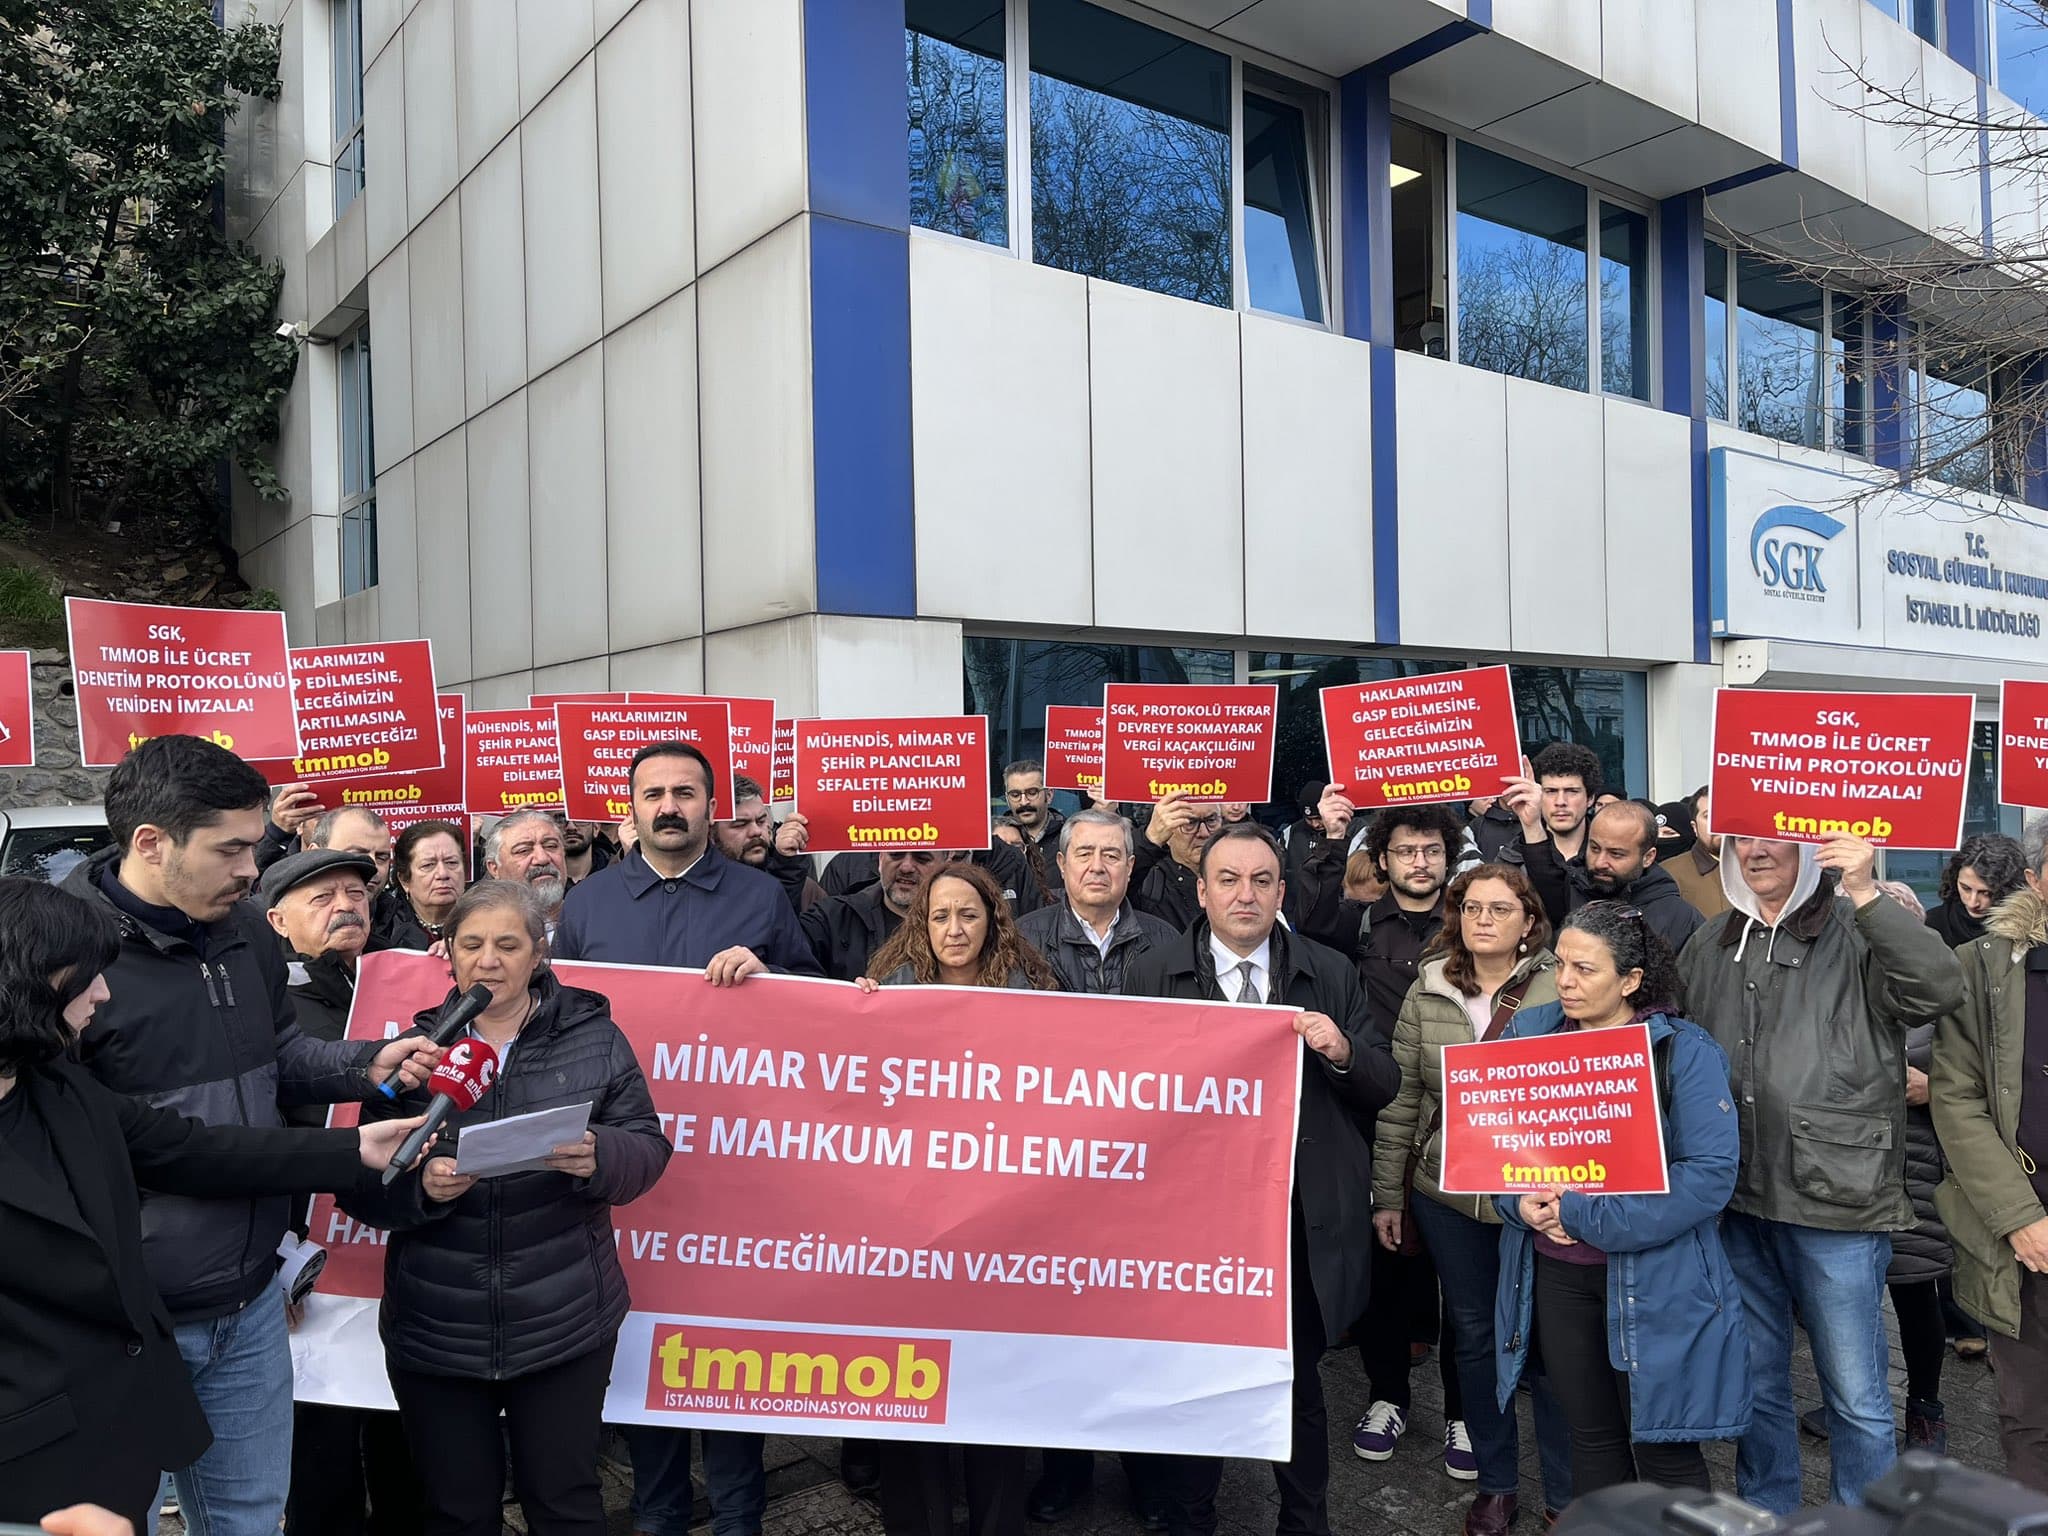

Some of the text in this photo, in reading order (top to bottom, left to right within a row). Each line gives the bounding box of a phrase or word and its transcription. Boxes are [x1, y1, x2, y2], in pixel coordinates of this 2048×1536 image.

[1965, 532, 1989, 559] T.C.
[1763, 538, 1827, 593] SGK
[1887, 549, 1942, 581] SOSYAL
[1944, 557, 2003, 592] GÜVENLİK
[1906, 594, 1963, 629] İSTANBUL
[1964, 603, 1975, 630] İL
[148, 624, 186, 643] SGK,
[99, 646, 252, 666] TMMOB İLE ÜCRET
[291, 651, 385, 670] KLARIMIZIN
[79, 669, 141, 688] DENETİM
[146, 672, 286, 689] PROTOKOLÜNÜ
[306, 669, 403, 690] EDİLMESİNE,
[295, 689, 394, 711] LECEĞİMİZİN
[1359, 679, 1463, 704] HAKLARIMIZIN
[106, 694, 254, 713] YENİDEN İMZALA!
[1110, 703, 1271, 717] SGK, PROTOKOLÜ TEKRAR
[1352, 697, 1481, 724] GASP EDİLMESİNE,
[299, 709, 406, 731] ARTILMASINA
[467, 719, 533, 734] MÜHENDİS,
[591, 711, 687, 723] HAKLARIMIZIN
[1816, 711, 1860, 728] SGK,
[583, 727, 702, 742] GASP EDİLMESİNE,
[730, 726, 751, 736] RET
[1064, 729, 1101, 738] TMMOB
[1117, 722, 1263, 734] DEVREYE SOKMAYARAK
[1364, 716, 1473, 742] GELECEĞİMİZİN
[299, 727, 418, 751] VERMEYECEĞİZ!
[479, 739, 512, 752] ŞEHİR
[806, 730, 894, 749] MÜHENDİS,
[898, 729, 953, 746] MİMAR
[957, 732, 976, 745] VE
[1048, 740, 1090, 751] DENETİM
[1123, 738, 1255, 754] VERGİ KAÇAKÇILIĞINI
[1358, 736, 1486, 761] KARARTILMASINA
[1750, 731, 1931, 752] TMMOB İLE ÜCRET
[2005, 734, 2048, 750] DENE
[292, 747, 390, 773] tmmob
[477, 754, 560, 766] SEFALETE MAH
[821, 753, 960, 773] ŞEHİR PLANCILARI
[1142, 756, 1237, 772] TEŞVİK EDİYOR!
[1354, 754, 1498, 781] İZİN VERMEYECEĞİZ!
[1717, 753, 1963, 777] DENETİM PROTOKOLÜNÜ
[503, 769, 561, 782] EDİLEMEZ
[817, 776, 966, 791] SEFALETE MAHKUM
[1381, 773, 1471, 797] tmmob
[342, 784, 422, 803] tmmob
[584, 781, 608, 795] İZİN
[1148, 779, 1227, 795] tmmob
[1750, 777, 1923, 800] YENİDEN İMZALA!
[852, 796, 932, 812] EDİLEMEZ!
[847, 822, 938, 841] tmmob
[1773, 811, 1892, 837] tmmob
[436, 1064, 466, 1081] anka
[652, 1033, 1263, 1117] MİMAR VE ŞEHİR PLANCILARI
[1450, 1053, 1645, 1084] SGK, PROTOKOLÜ TEKRAR
[1460, 1078, 1638, 1105] DEVREYE SOKMAYARAK
[1468, 1101, 1632, 1127] VERGİ KAÇAKÇILIĞINI
[708, 1115, 913, 1168] MAHKUM
[926, 1121, 1148, 1181] EDİLEMEZ!
[1492, 1128, 1611, 1151] TEŞVİK EDİYOR!
[1502, 1159, 1606, 1182] tmmob
[630, 1229, 668, 1262] VE
[676, 1232, 954, 1281] GELECEĞİMİZDEN
[963, 1251, 1274, 1298] VAZGEÇMEYECEĞİZ!
[658, 1332, 941, 1400] tmmob
[664, 1390, 928, 1419] İSTANBUL İL KOORDİNASYON KURULU
